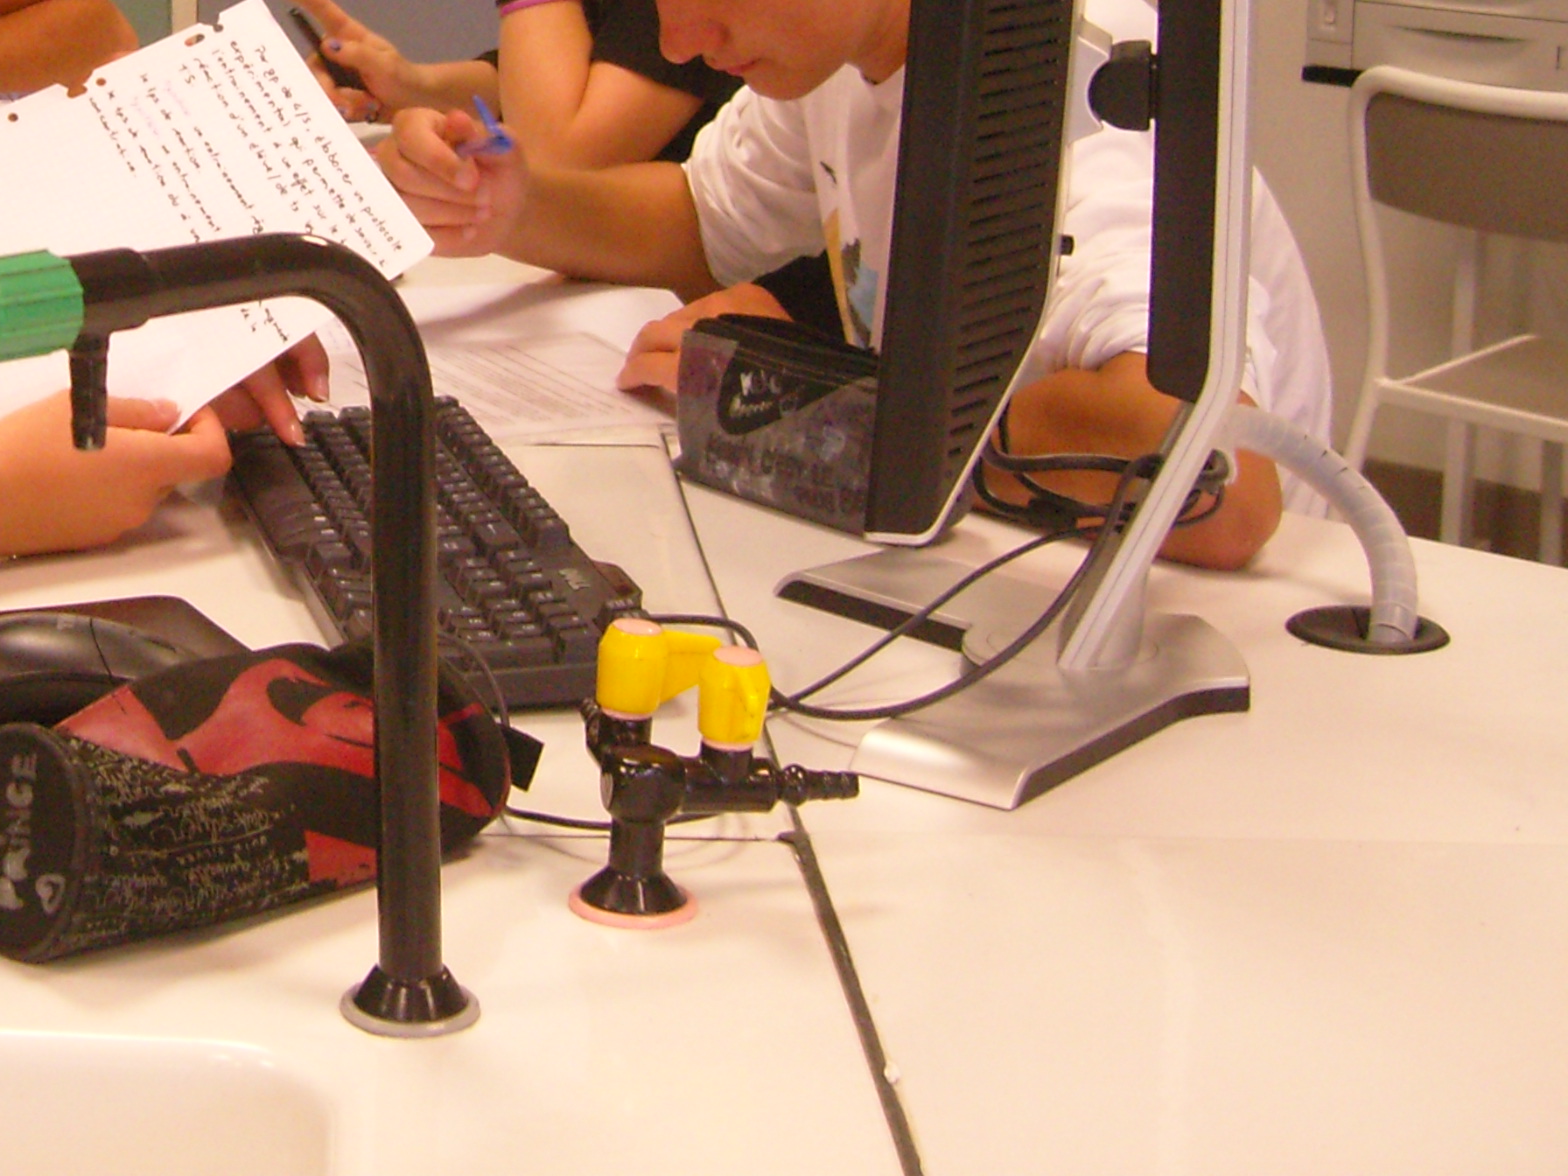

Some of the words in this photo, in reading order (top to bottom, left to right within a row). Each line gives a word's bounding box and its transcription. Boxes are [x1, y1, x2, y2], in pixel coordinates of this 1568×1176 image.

[229, 40, 291, 128] expérimental
[301, 158, 346, 210] permette
[360, 205, 403, 252] protocole
